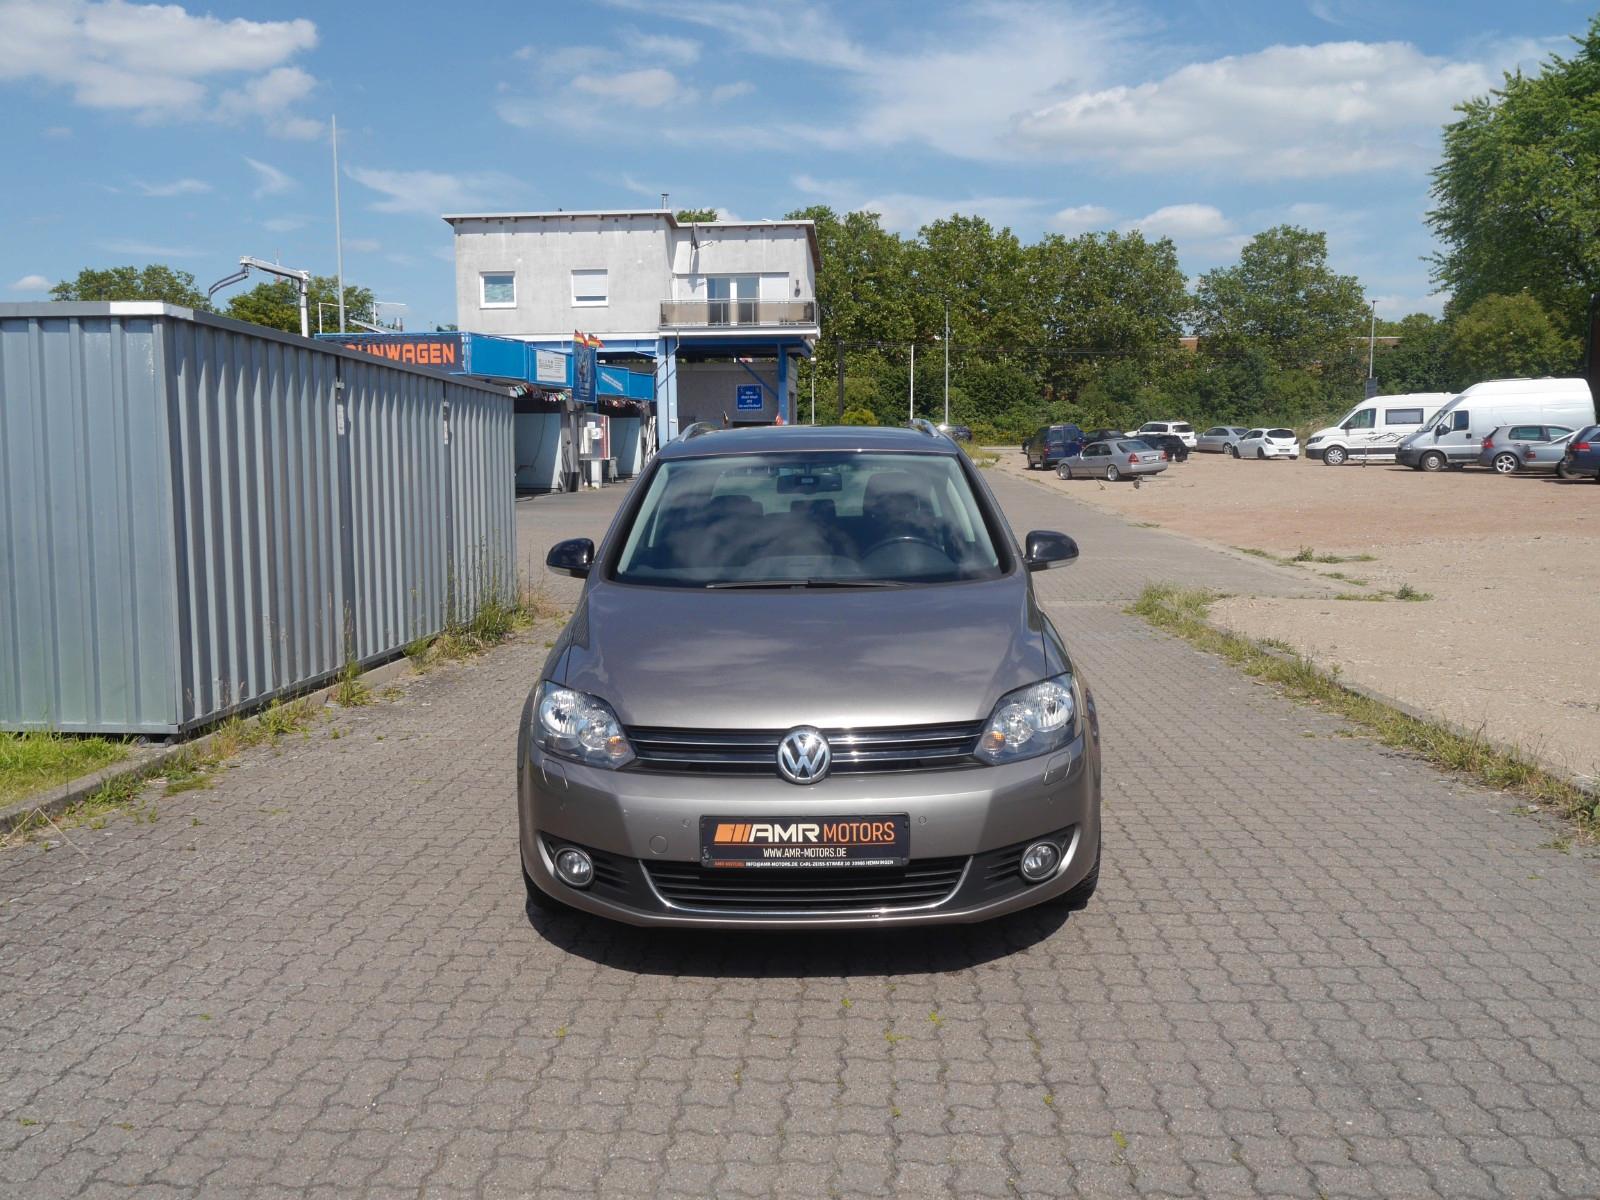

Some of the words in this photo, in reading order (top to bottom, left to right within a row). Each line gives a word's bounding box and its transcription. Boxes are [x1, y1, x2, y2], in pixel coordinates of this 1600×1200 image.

[345, 343, 455, 364] NWAGEN
[749, 823, 820, 843] AMR
[823, 822, 895, 843] MOTORS
[763, 847, 847, 858] WWW.AMR-MOTORS.DE
